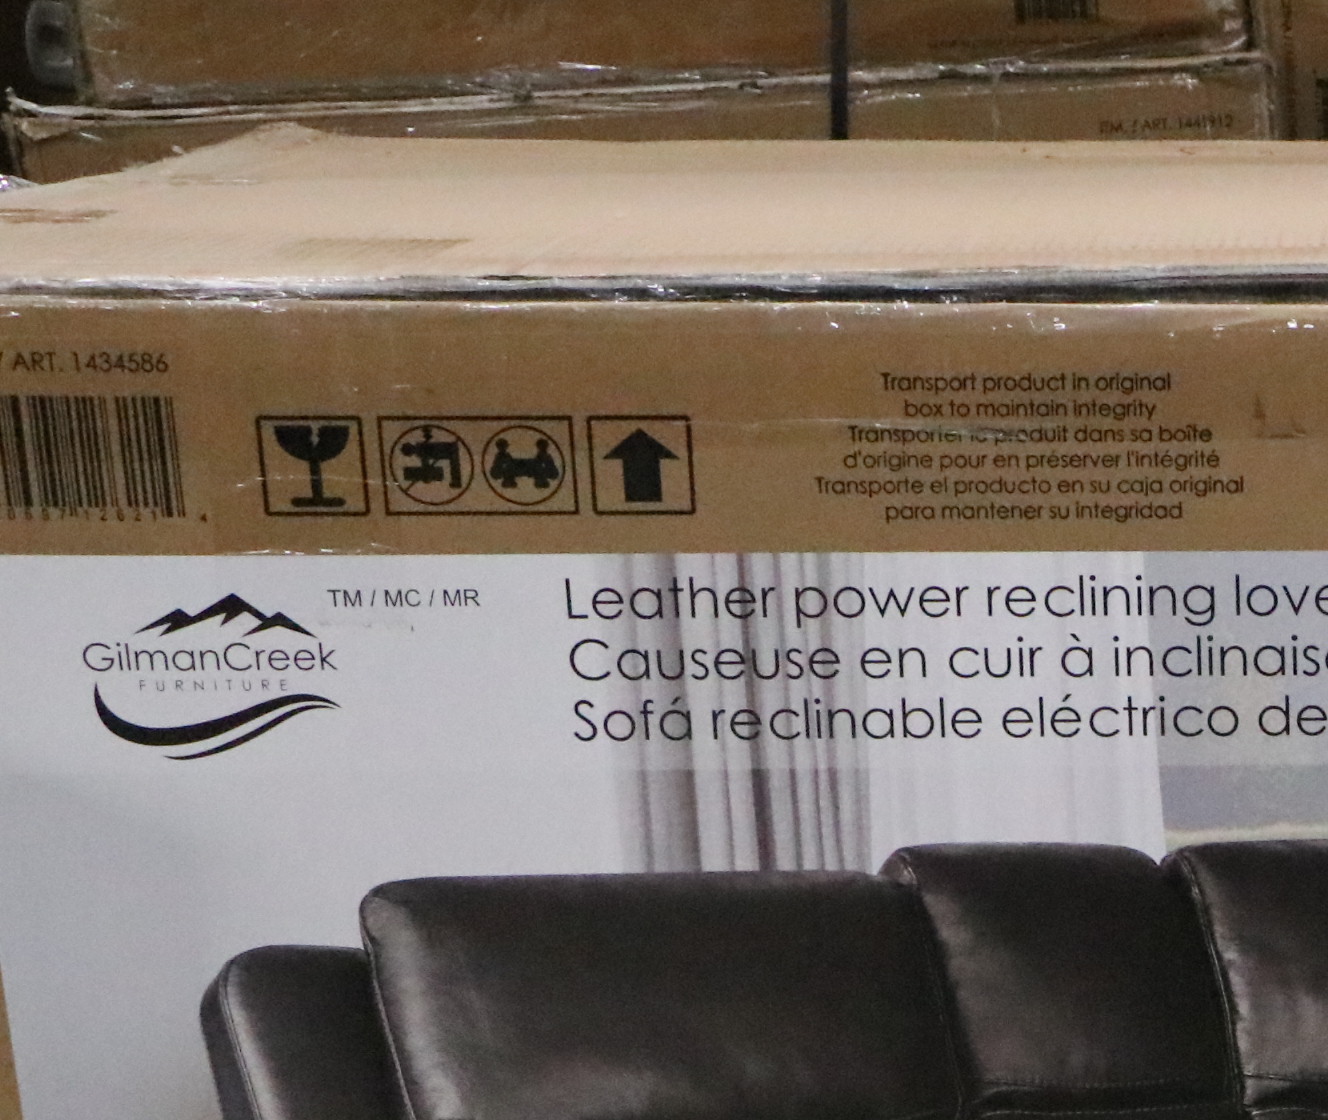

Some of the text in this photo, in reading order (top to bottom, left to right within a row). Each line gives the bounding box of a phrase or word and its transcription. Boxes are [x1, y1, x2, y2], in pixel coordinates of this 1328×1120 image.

[11, 351, 169, 373] ART. 1434586
[880, 372, 1171, 395] Transport product in original
[903, 399, 1156, 421] box to maintain integrity
[939, 454, 987, 472] pour
[992, 454, 1020, 468] en
[1025, 451, 1121, 472] préserver
[814, 475, 1244, 498] Transporte el producto en su caja original
[327, 589, 362, 607] TM
[384, 589, 421, 607] MC
[443, 589, 480, 606] MR
[565, 576, 776, 620] Leather
[795, 586, 969, 628] power
[987, 575, 1215, 627] reclining
[82, 642, 338, 672] GilmanCreek
[569, 637, 840, 682] Causeuse
[860, 647, 927, 679] en
[949, 636, 1043, 679] cuir
[1061, 633, 1093, 678] à
[138, 679, 290, 692] FURNITURE
[574, 696, 692, 742] Sofá
[712, 697, 982, 741] reclinable
[1002, 693, 1239, 738] eléctrico
[1258, 695, 1328, 737] de
